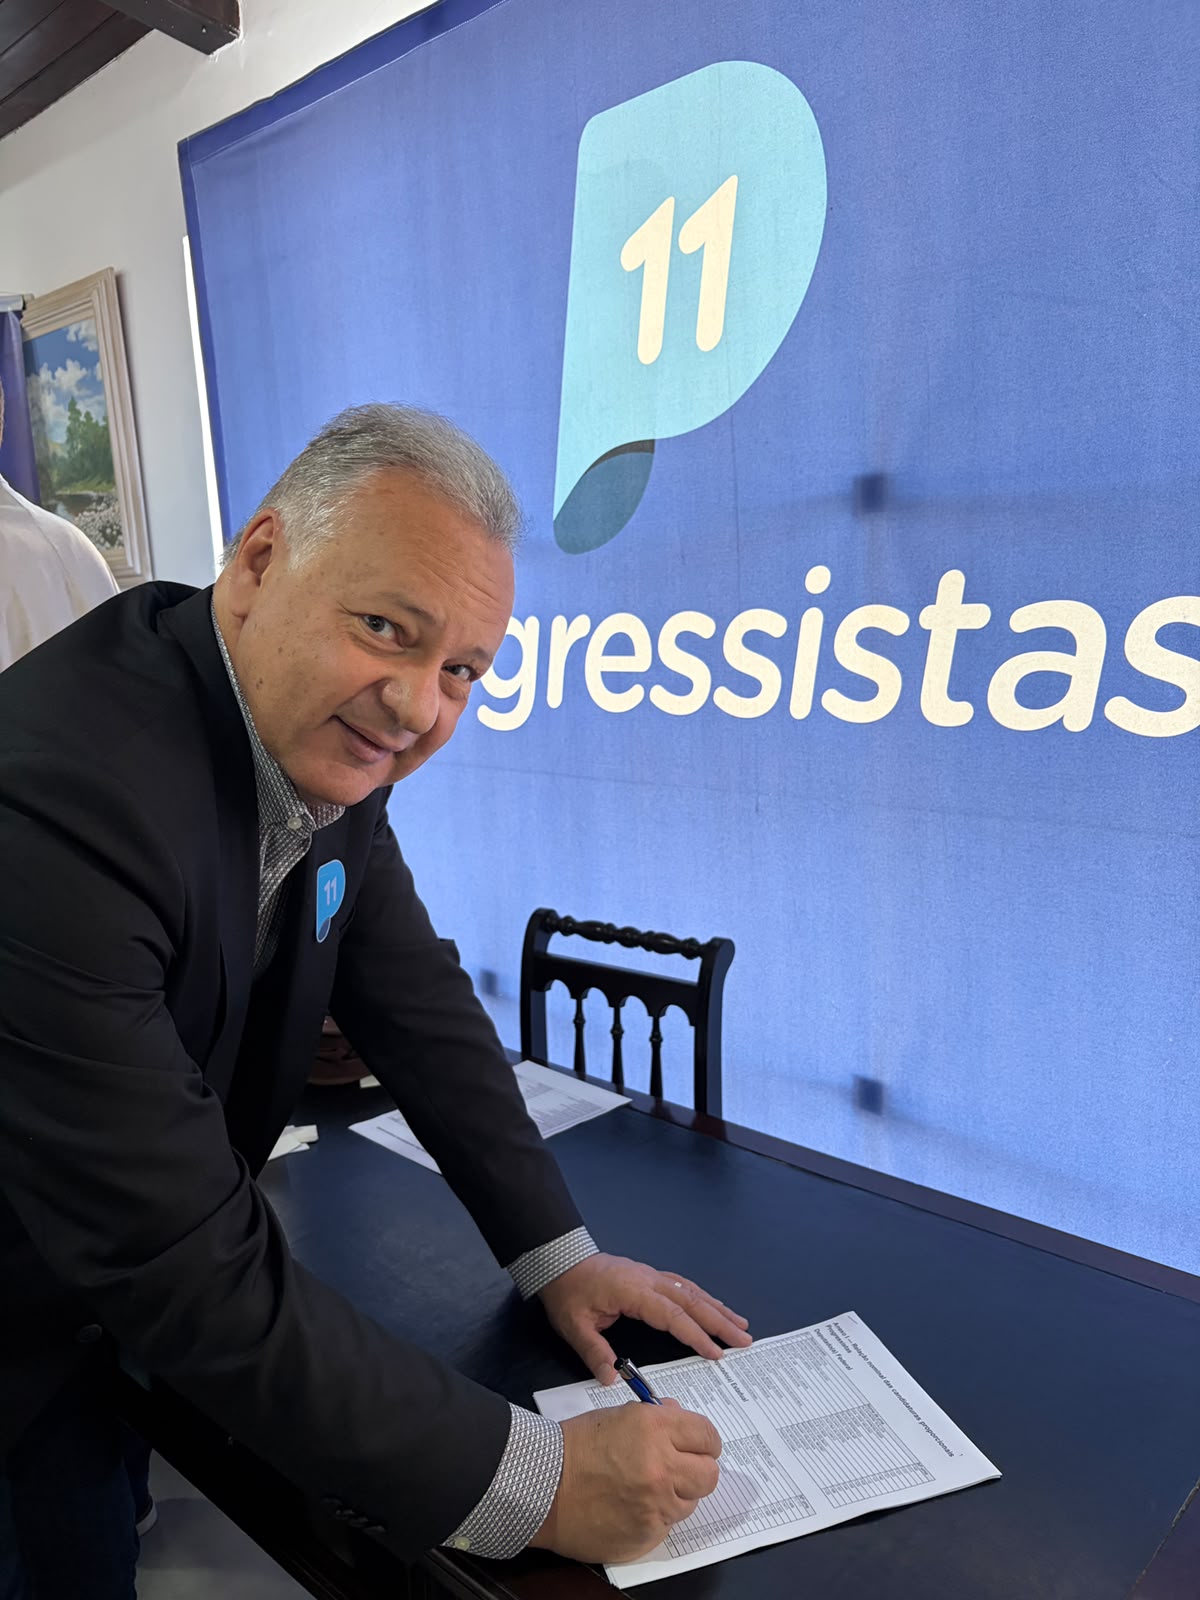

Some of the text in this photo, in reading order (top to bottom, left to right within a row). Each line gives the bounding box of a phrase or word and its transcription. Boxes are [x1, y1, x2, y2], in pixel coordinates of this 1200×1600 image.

[620, 175, 739, 365] 11
[477, 566, 1200, 737] gressistas
[323, 875, 337, 906] 11
[826, 1324, 852, 1353] Progressistas
[836, 1353, 853, 1370] Federal
[852, 1343, 869, 1361] Relação
[867, 1361, 886, 1379] nominal
[883, 1379, 893, 1388] das
[892, 1388, 921, 1421] candidaturas
[919, 1420, 954, 1457] proporcionais
